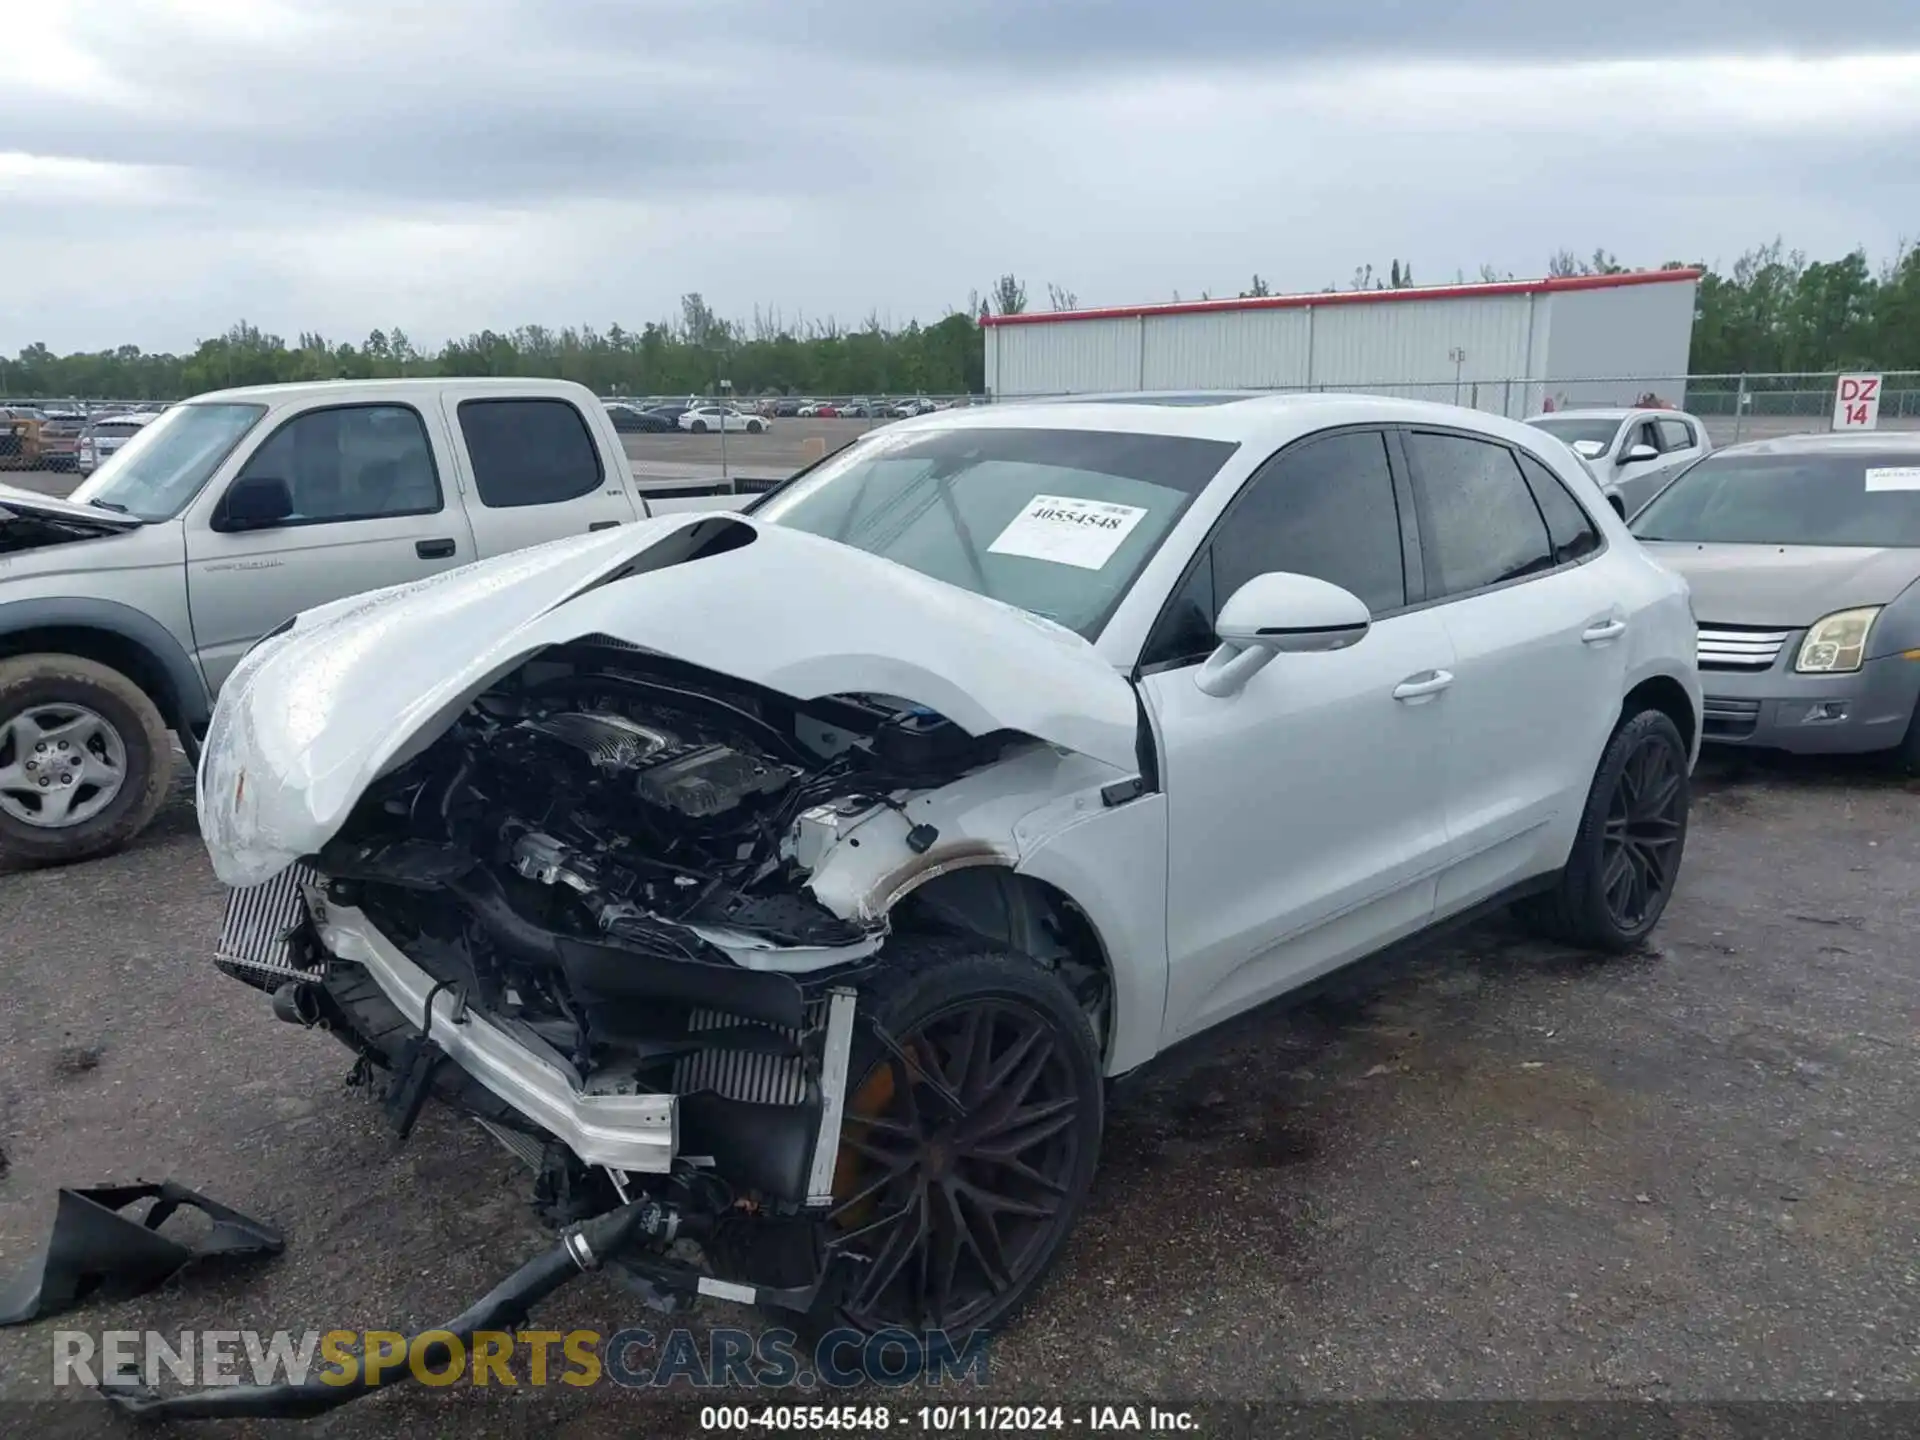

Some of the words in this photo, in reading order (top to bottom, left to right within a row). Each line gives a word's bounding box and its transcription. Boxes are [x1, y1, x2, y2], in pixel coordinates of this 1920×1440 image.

[1841, 379, 1878, 401] DZ
[1844, 404, 1868, 425] 14
[1031, 507, 1122, 530] 40554548
